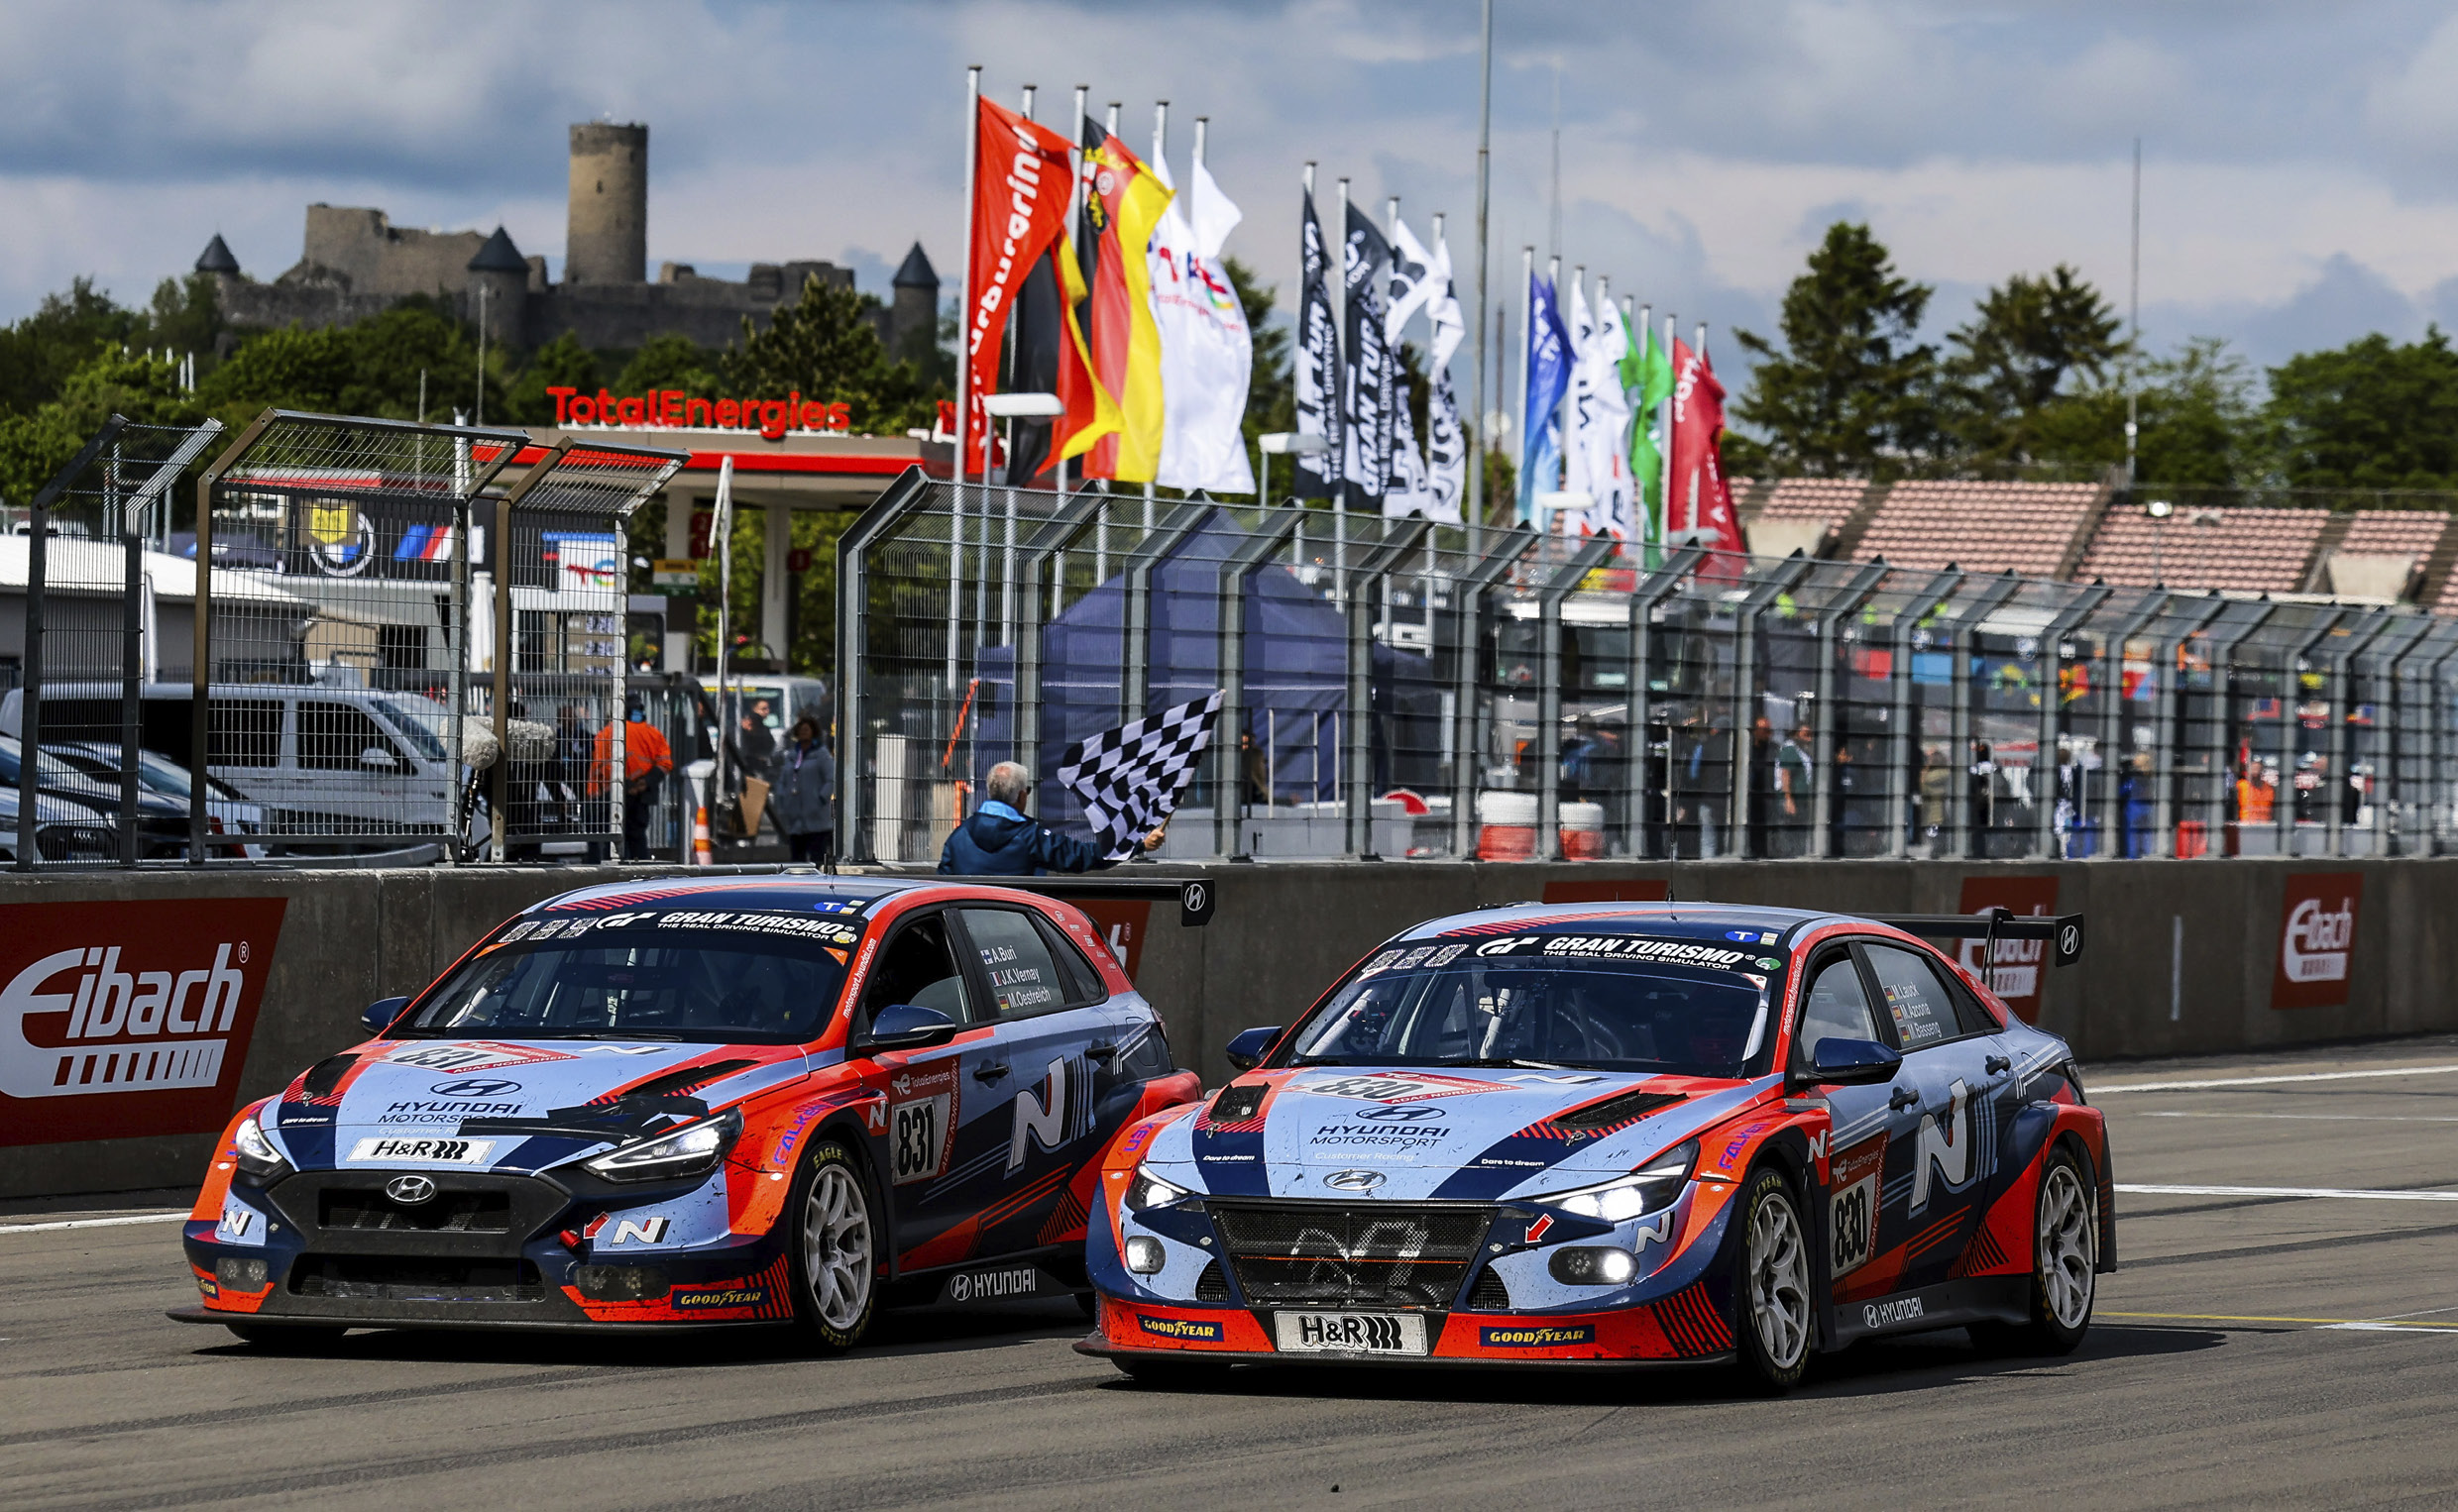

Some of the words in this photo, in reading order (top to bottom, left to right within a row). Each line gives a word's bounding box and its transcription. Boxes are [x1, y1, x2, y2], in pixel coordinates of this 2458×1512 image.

[1380, 354, 1393, 411] DRIVIN
[547, 386, 850, 439] TotalEnergies
[659, 912, 742, 924] GRAN
[740, 914, 840, 935] TURISMO
[713, 923, 760, 933] DRIVING
[762, 926, 830, 940] SIMULATOR
[1544, 936, 1623, 952] GRAN
[1627, 939, 1744, 964] TURISMO
[1604, 952, 1655, 961] DRIVING
[1657, 956, 1732, 970] SIMULATOR
[842, 937, 877, 1019] motorsport.hyundai.com
[1783, 954, 1803, 1036] motorsport.hyundai.com
[393, 1048, 494, 1069] 831
[453, 1065, 489, 1074] ADAC
[493, 1055, 573, 1068] NORDRHEIN
[910, 1071, 951, 1088] TotalEnergies
[1312, 1078, 1424, 1099] 830
[1391, 1095, 1427, 1104] ADAC
[1431, 1085, 1511, 1097] NORDRHEIN
[387, 1102, 523, 1115] HYUNDAI
[942, 1136, 953, 1172] ADAC
[950, 1059, 958, 1134] NORDRHEIN
[378, 1115, 502, 1124] MOTORSP
[379, 1127, 444, 1135] Customer
[773, 1102, 831, 1165] FALKEN
[898, 1104, 934, 1177] 831
[1309, 1136, 1442, 1146] MOTORSPORT
[1316, 1126, 1451, 1136] HYUNDAI
[813, 1146, 842, 1169] EAGLE
[1314, 1151, 1371, 1160] Customer
[1373, 1152, 1414, 1161] Racing
[1718, 1123, 1770, 1171] FALKEN
[1869, 1219, 1878, 1257] ADAC
[1875, 1135, 1888, 1217] NORDRHEIN
[1835, 1185, 1867, 1269] 830
[974, 1268, 1036, 1298] HYUNDAI
[680, 1290, 761, 1306] GOODYEAR
[1879, 1296, 1924, 1324] HYUNDAI
[1144, 1320, 1215, 1338] GOODYEAR
[1490, 1328, 1585, 1346] GOODYEAR
